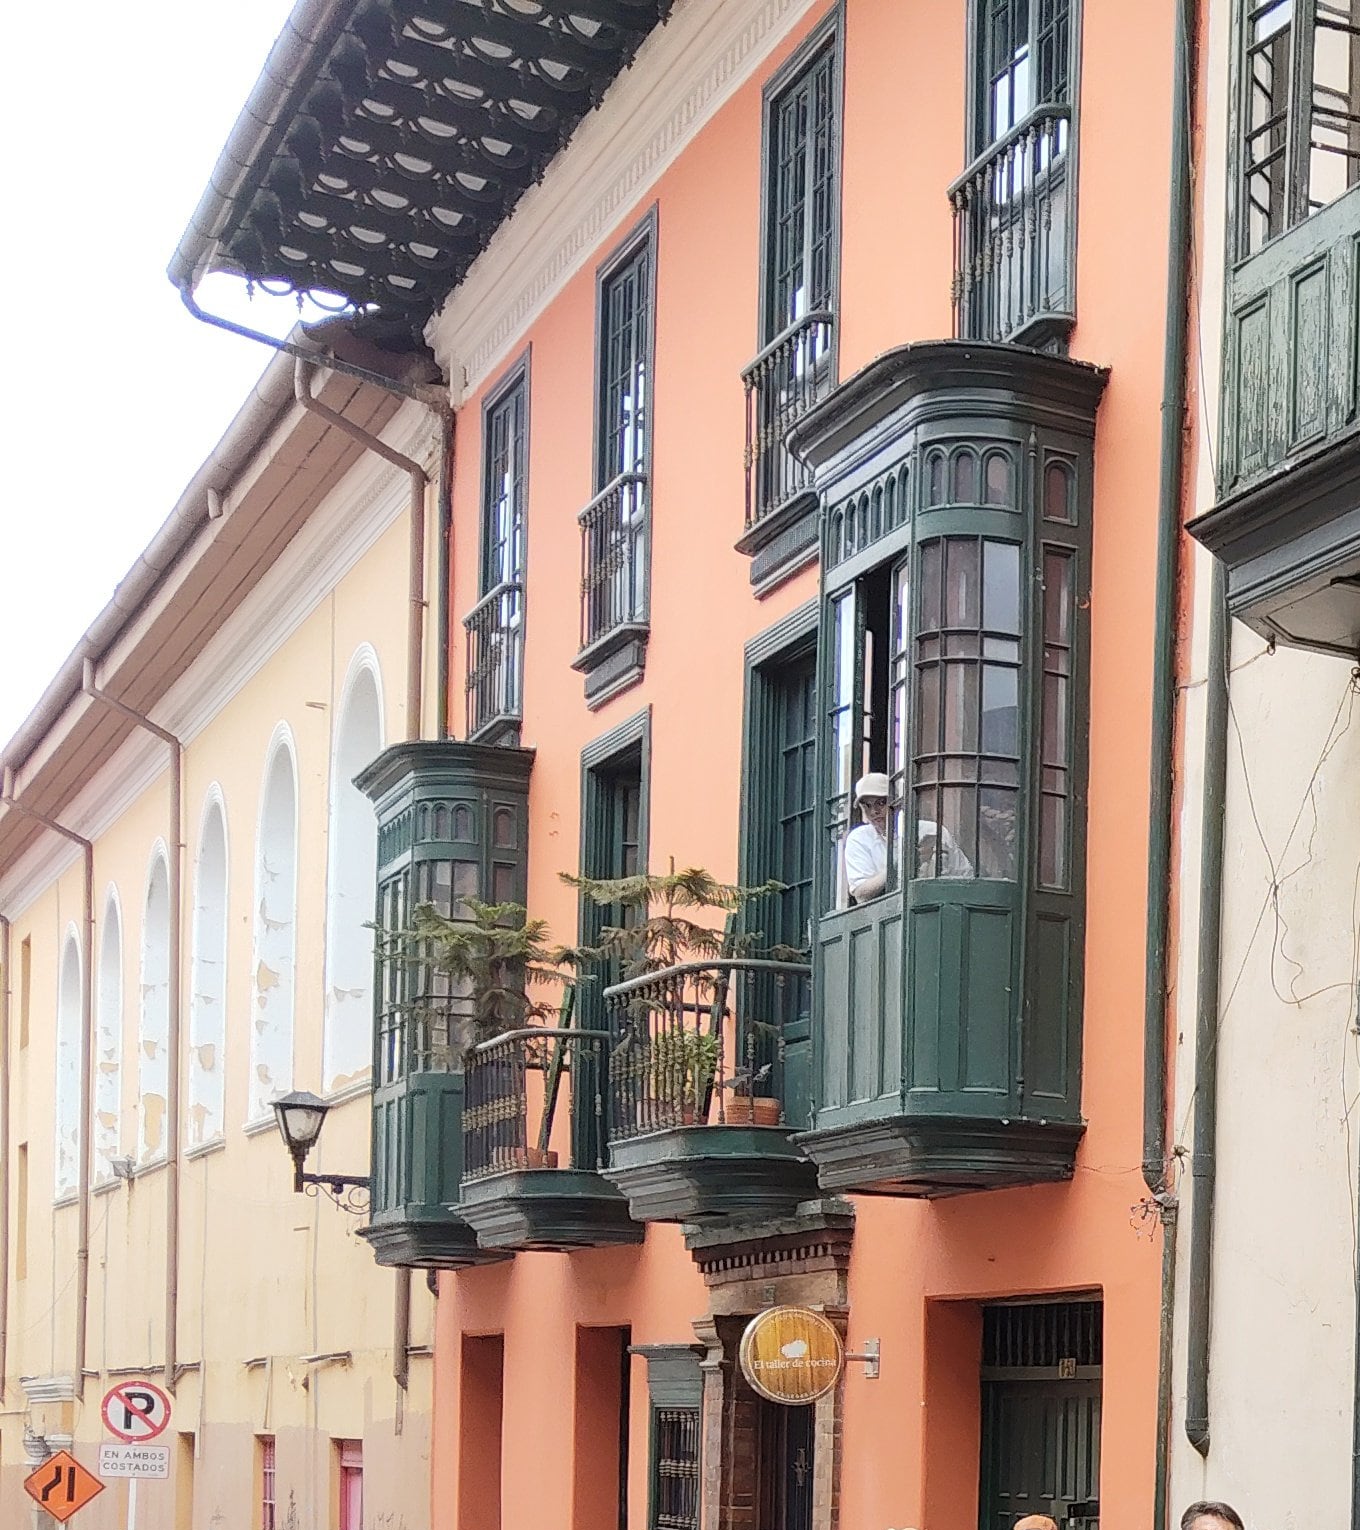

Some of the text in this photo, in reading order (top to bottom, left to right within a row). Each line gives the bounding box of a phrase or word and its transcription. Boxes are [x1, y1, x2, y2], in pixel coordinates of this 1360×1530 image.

[754, 1360, 764, 1369] El
[766, 1360, 791, 1369] taller
[792, 1358, 804, 1368] de
[104, 1450, 165, 1461] EN AMBOS
[103, 1462, 165, 1472] COSTADOS
